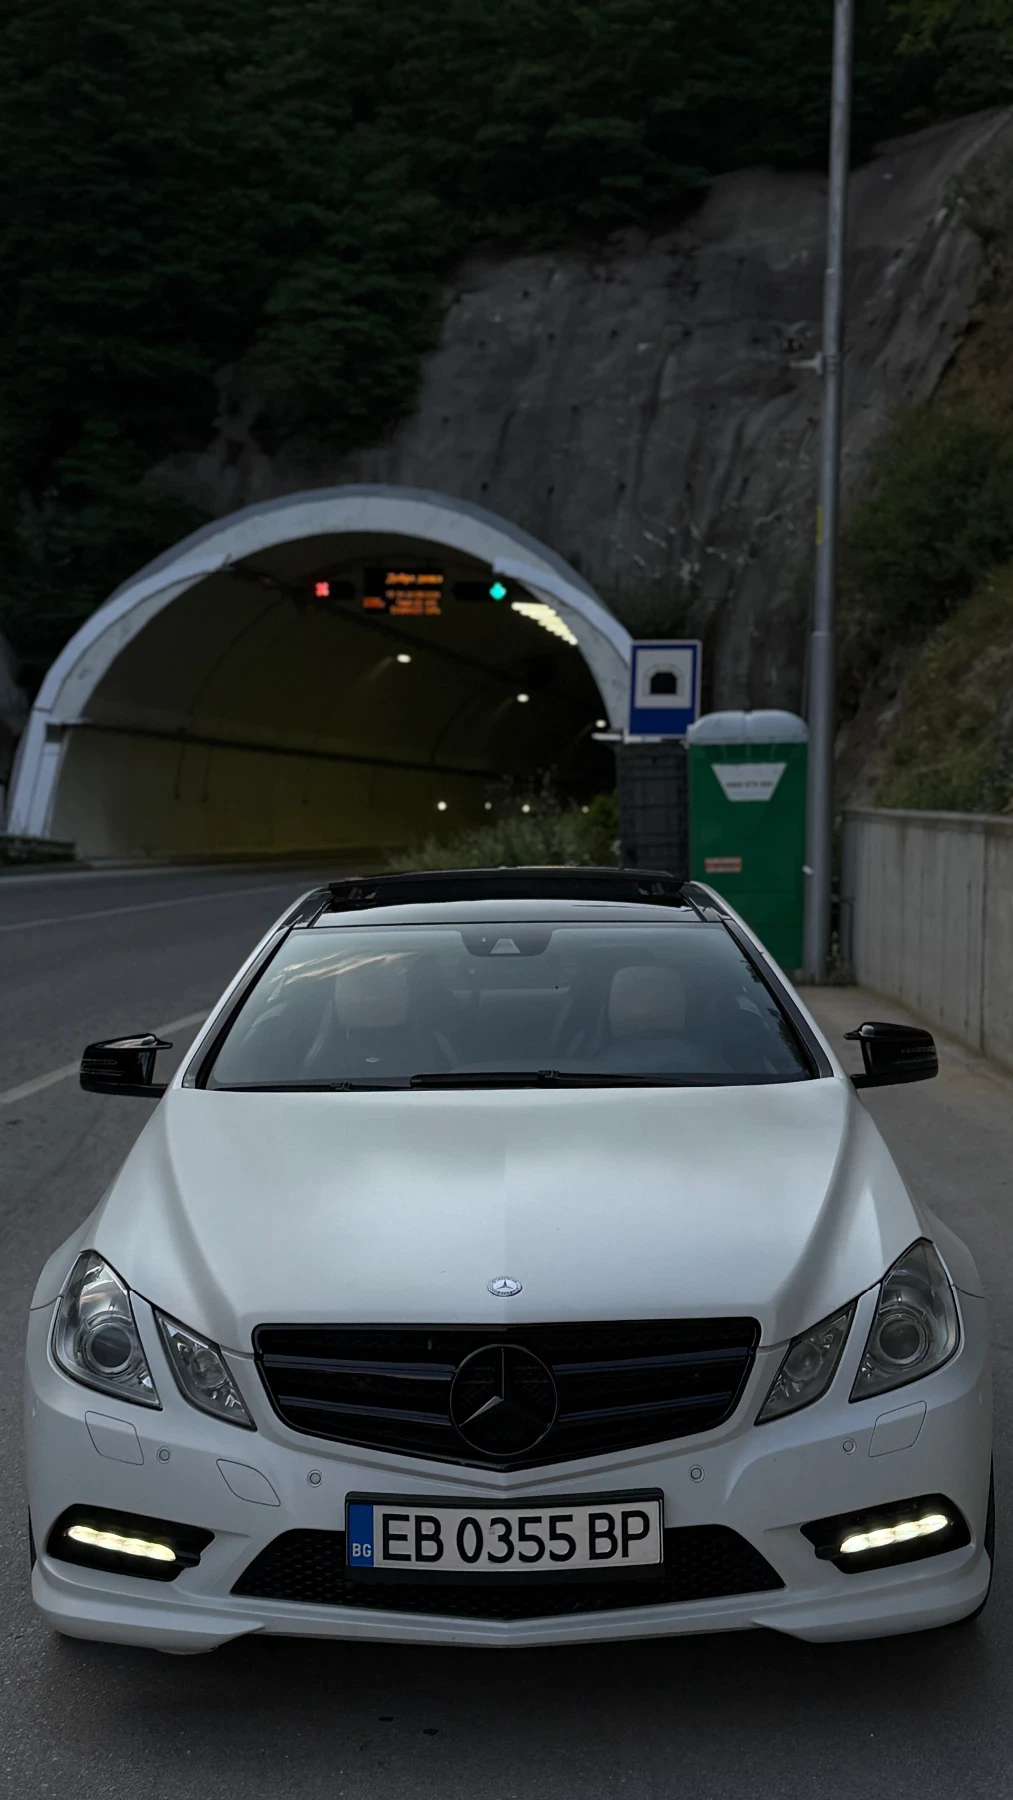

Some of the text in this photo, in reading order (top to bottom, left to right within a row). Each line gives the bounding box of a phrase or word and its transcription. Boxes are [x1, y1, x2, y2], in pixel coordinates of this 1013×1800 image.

[352, 1543, 372, 1558] BG
[382, 1510, 650, 1564] EB 0355 BP
